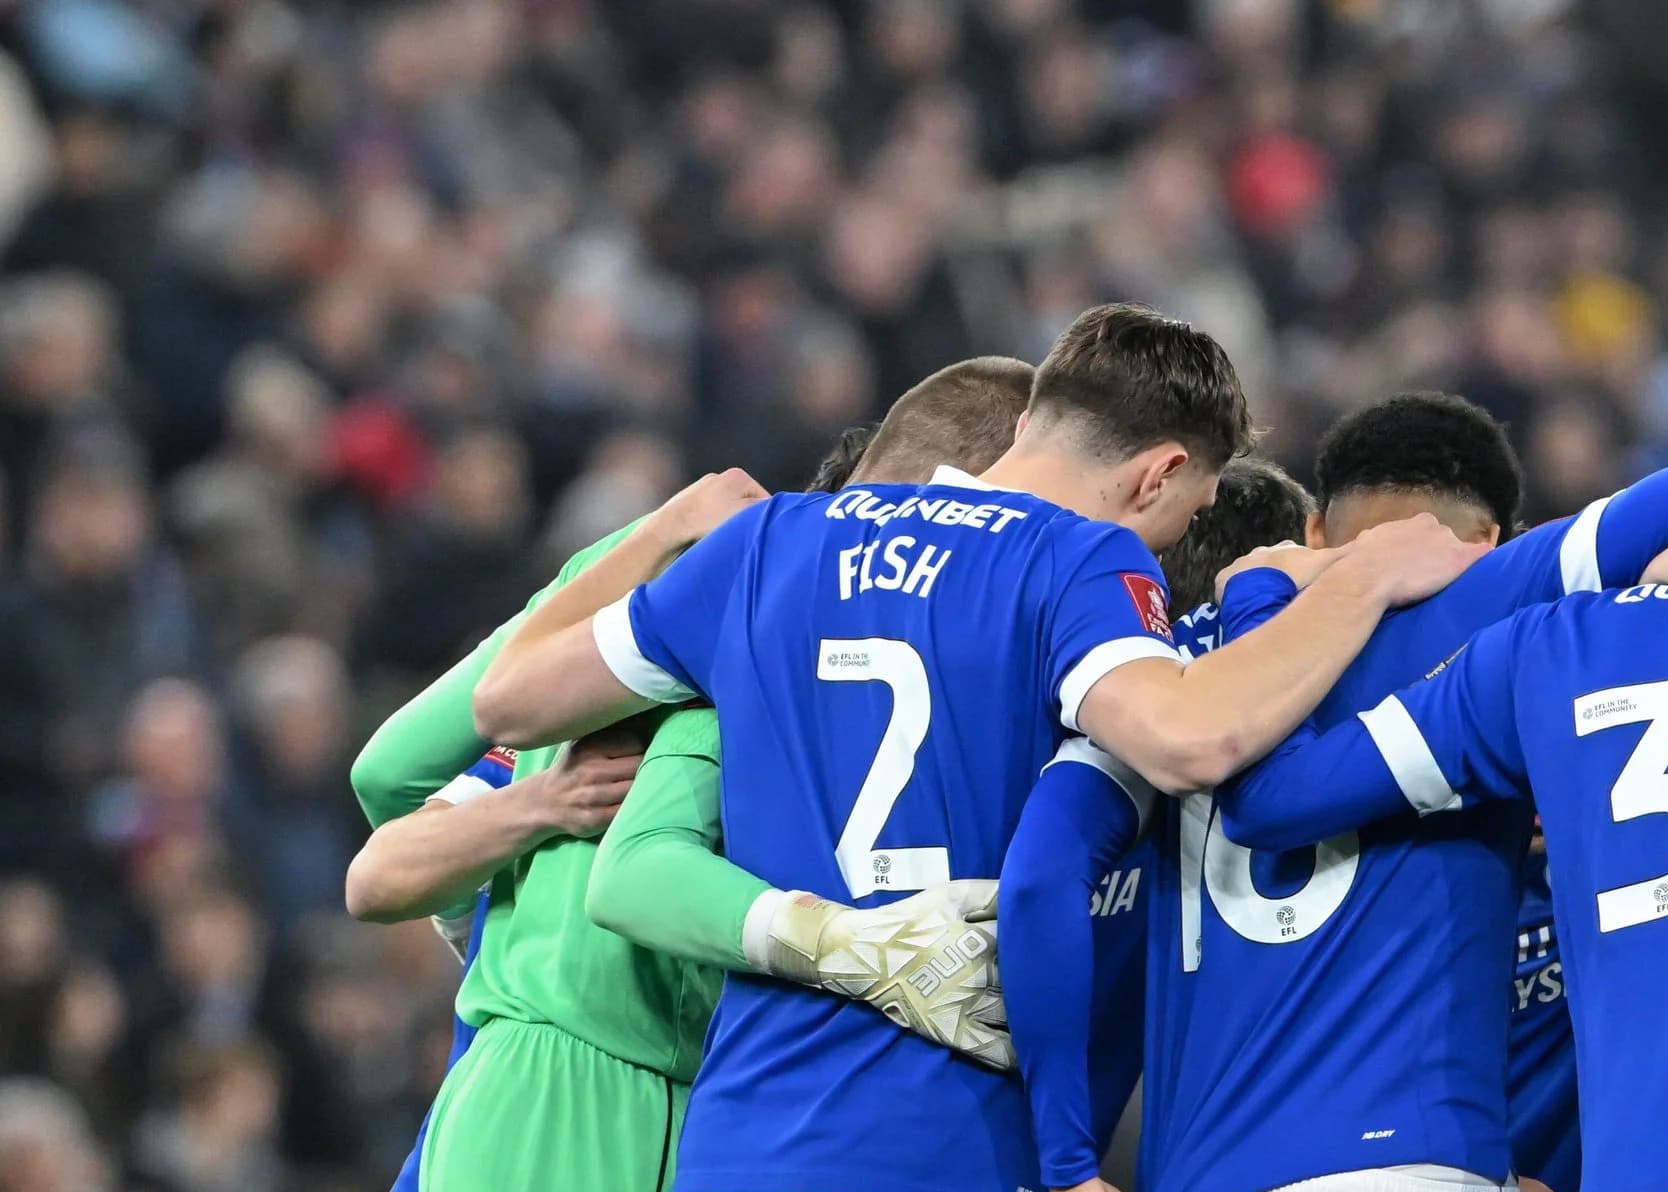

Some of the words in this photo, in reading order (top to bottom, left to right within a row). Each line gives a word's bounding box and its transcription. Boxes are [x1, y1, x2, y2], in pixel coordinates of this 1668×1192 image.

[839, 535, 952, 601] FISH
[1595, 703, 1638, 718] COMMUNITY
[817, 637, 951, 900] 2
[874, 875, 890, 885] EFL
[1281, 925, 1297, 936] EFL
